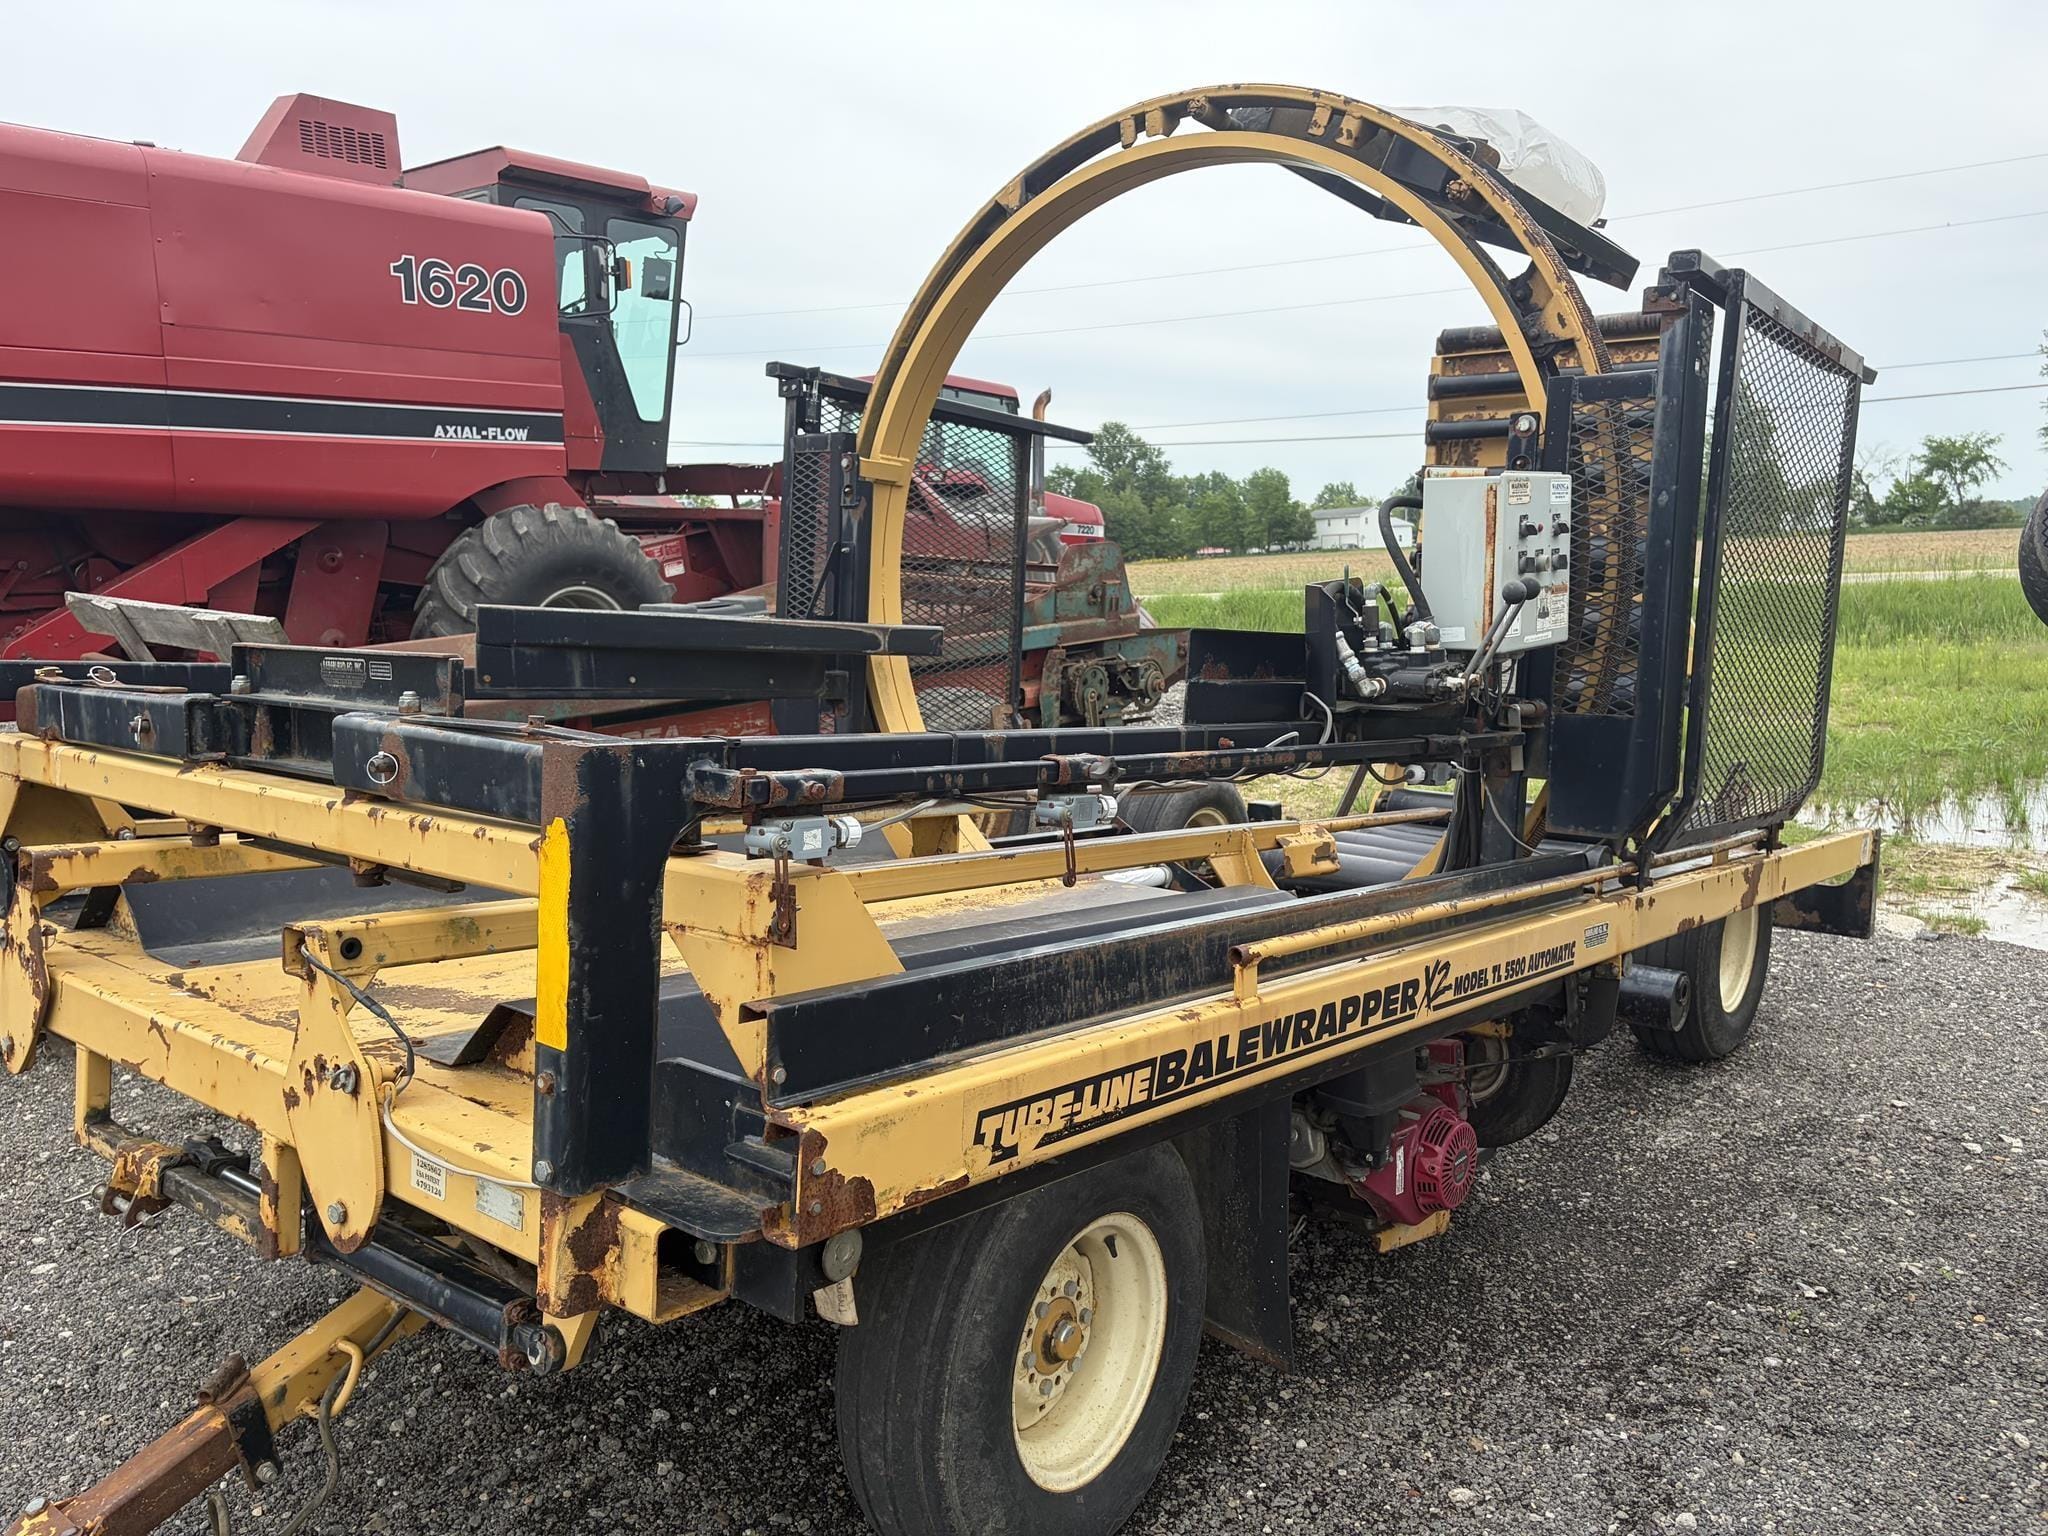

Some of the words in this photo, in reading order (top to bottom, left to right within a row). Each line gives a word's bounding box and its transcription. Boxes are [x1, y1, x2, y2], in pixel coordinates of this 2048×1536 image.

[390, 254, 527, 316] 1620
[434, 424, 529, 441] AXIAL-FLOW
[1077, 525, 1095, 535] 7220
[979, 1065, 1152, 1148] TUBE-LINE
[1155, 978, 1420, 1096] BALEWRAPPER
[1453, 972, 1489, 997] MODEL
[1491, 964, 1503, 984] TL
[1504, 956, 1526, 980] 5500
[1527, 940, 1577, 973] AUTOMATIC
